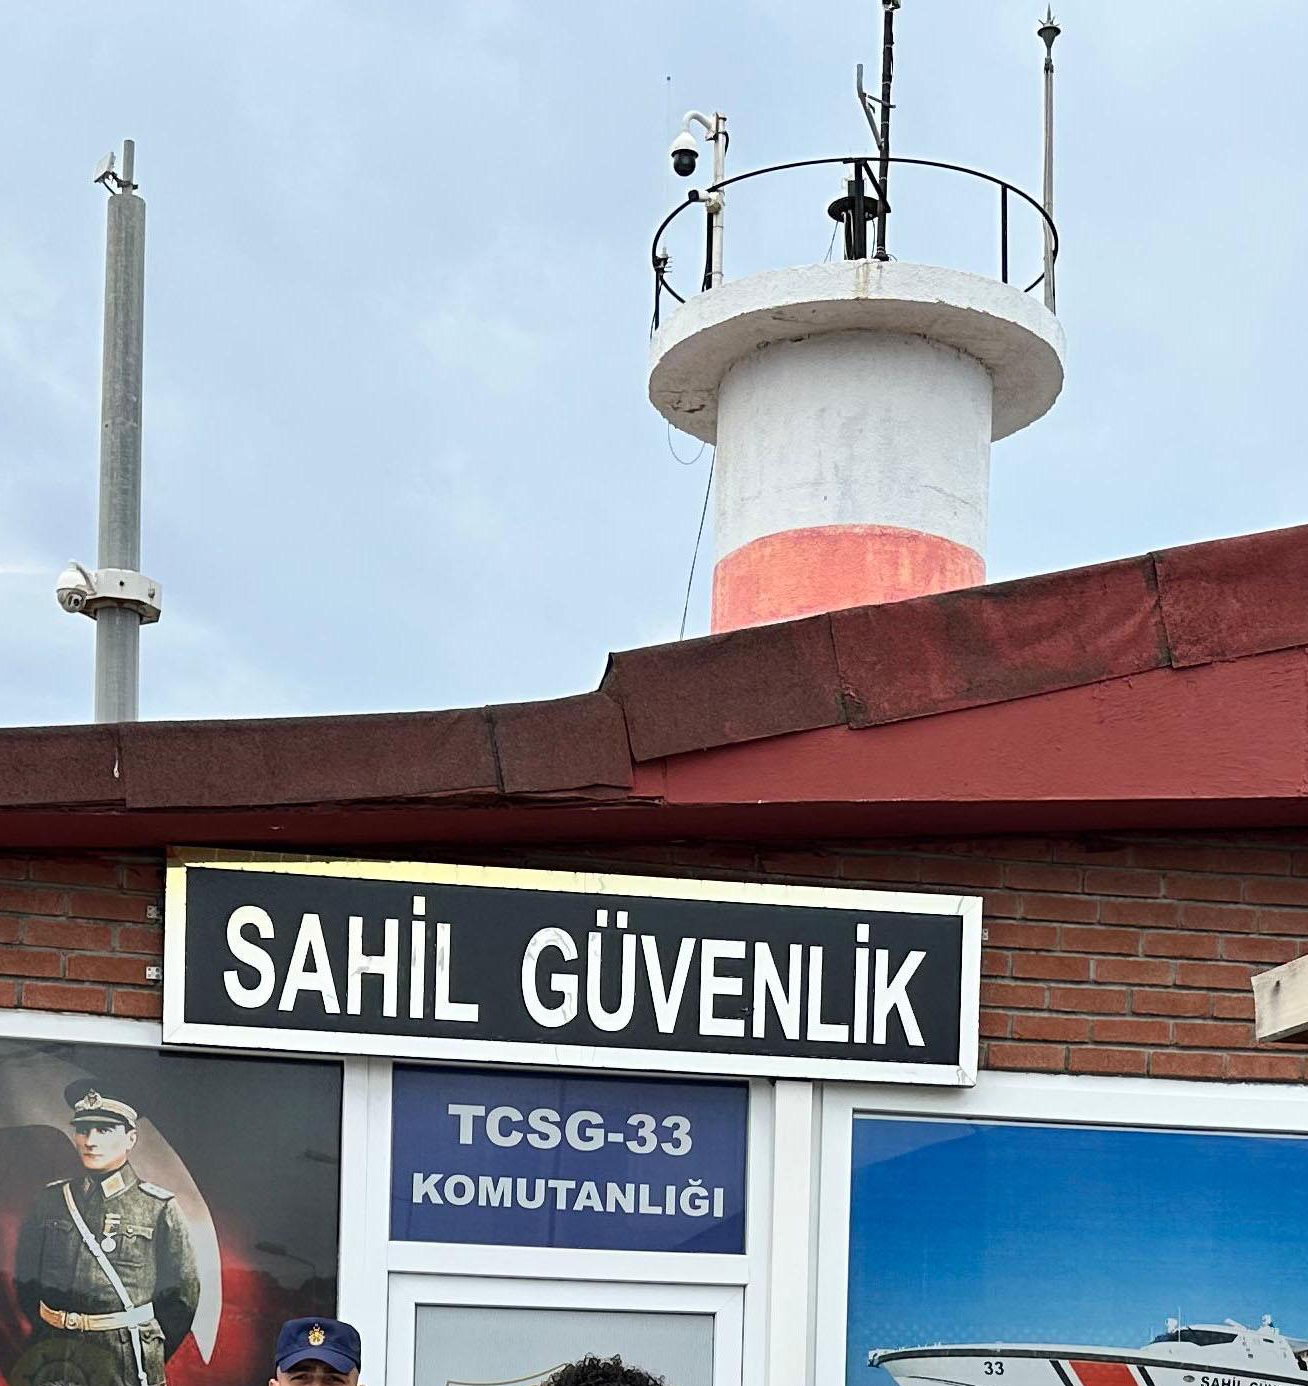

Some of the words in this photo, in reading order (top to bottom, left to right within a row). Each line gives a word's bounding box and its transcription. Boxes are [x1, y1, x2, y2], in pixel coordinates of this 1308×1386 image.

[223, 896, 479, 1023] SAHİL
[521, 909, 928, 1047] GÜVENLİK
[447, 1104, 693, 1156] TCSG-33
[412, 1174, 725, 1219] KOMUTANLIĞI
[983, 1361, 1005, 1376] 33
